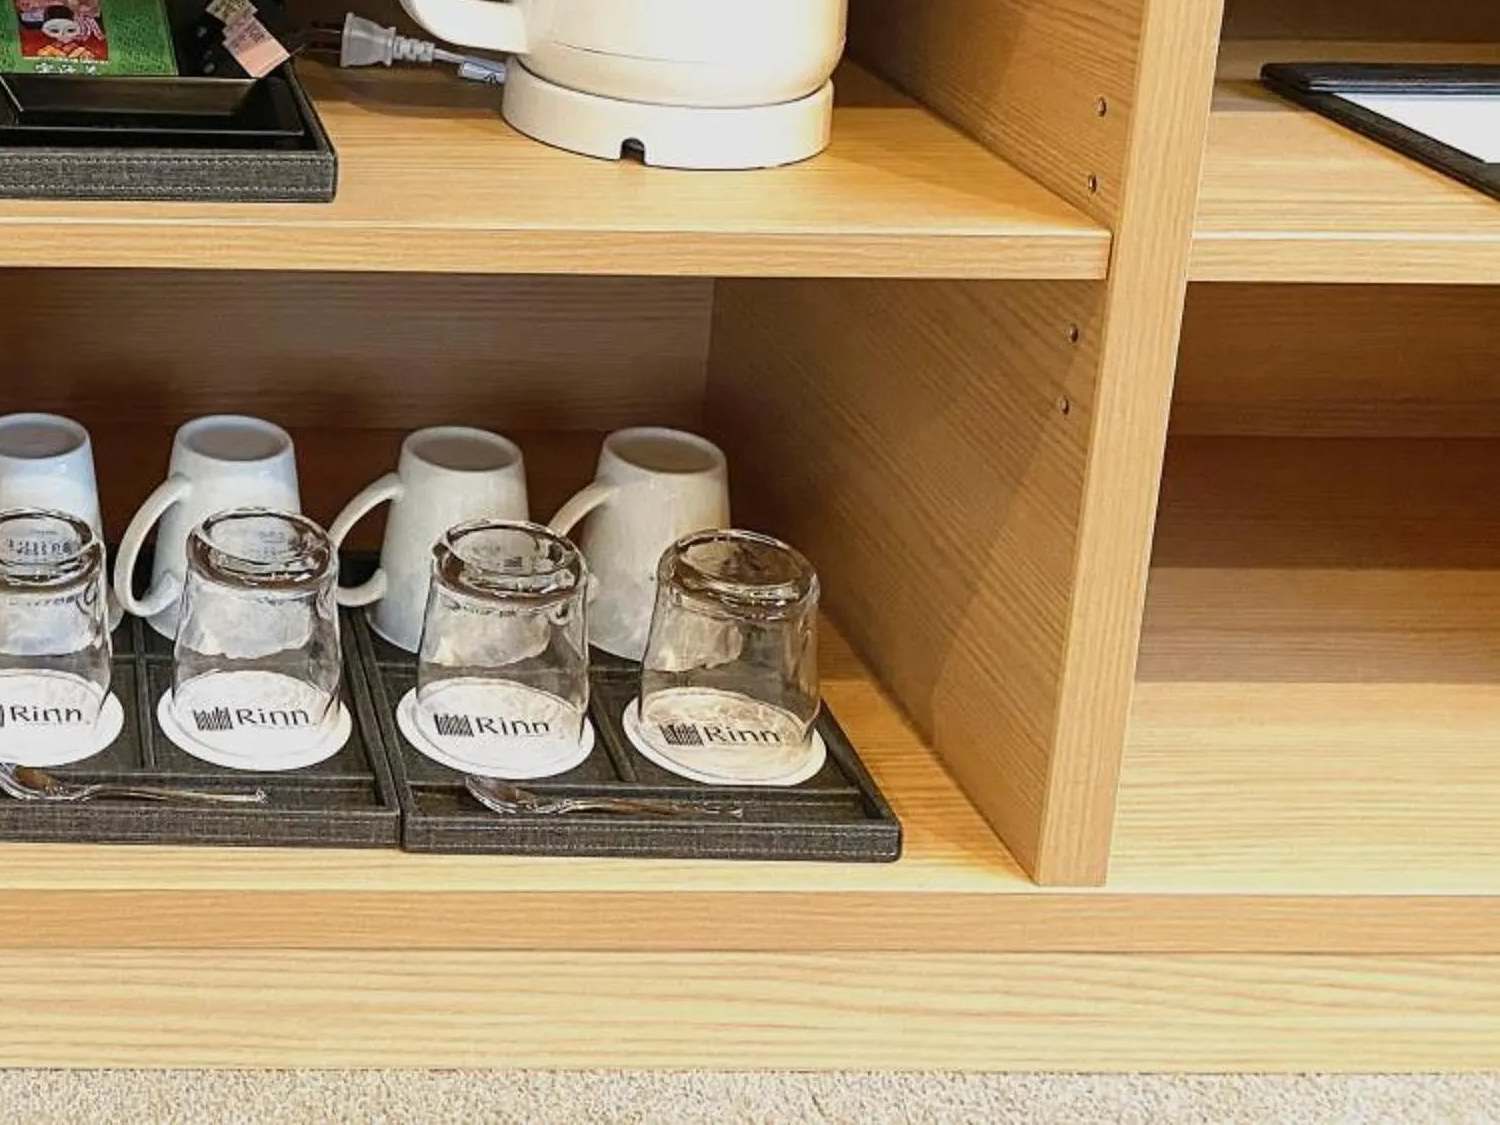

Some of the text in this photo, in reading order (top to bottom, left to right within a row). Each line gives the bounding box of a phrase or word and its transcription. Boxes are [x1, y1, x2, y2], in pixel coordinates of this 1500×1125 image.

[9, 705, 83, 724] Rinn
[235, 707, 310, 726] Rinn
[475, 716, 550, 736] Rinn
[703, 726, 781, 742] Rinn
